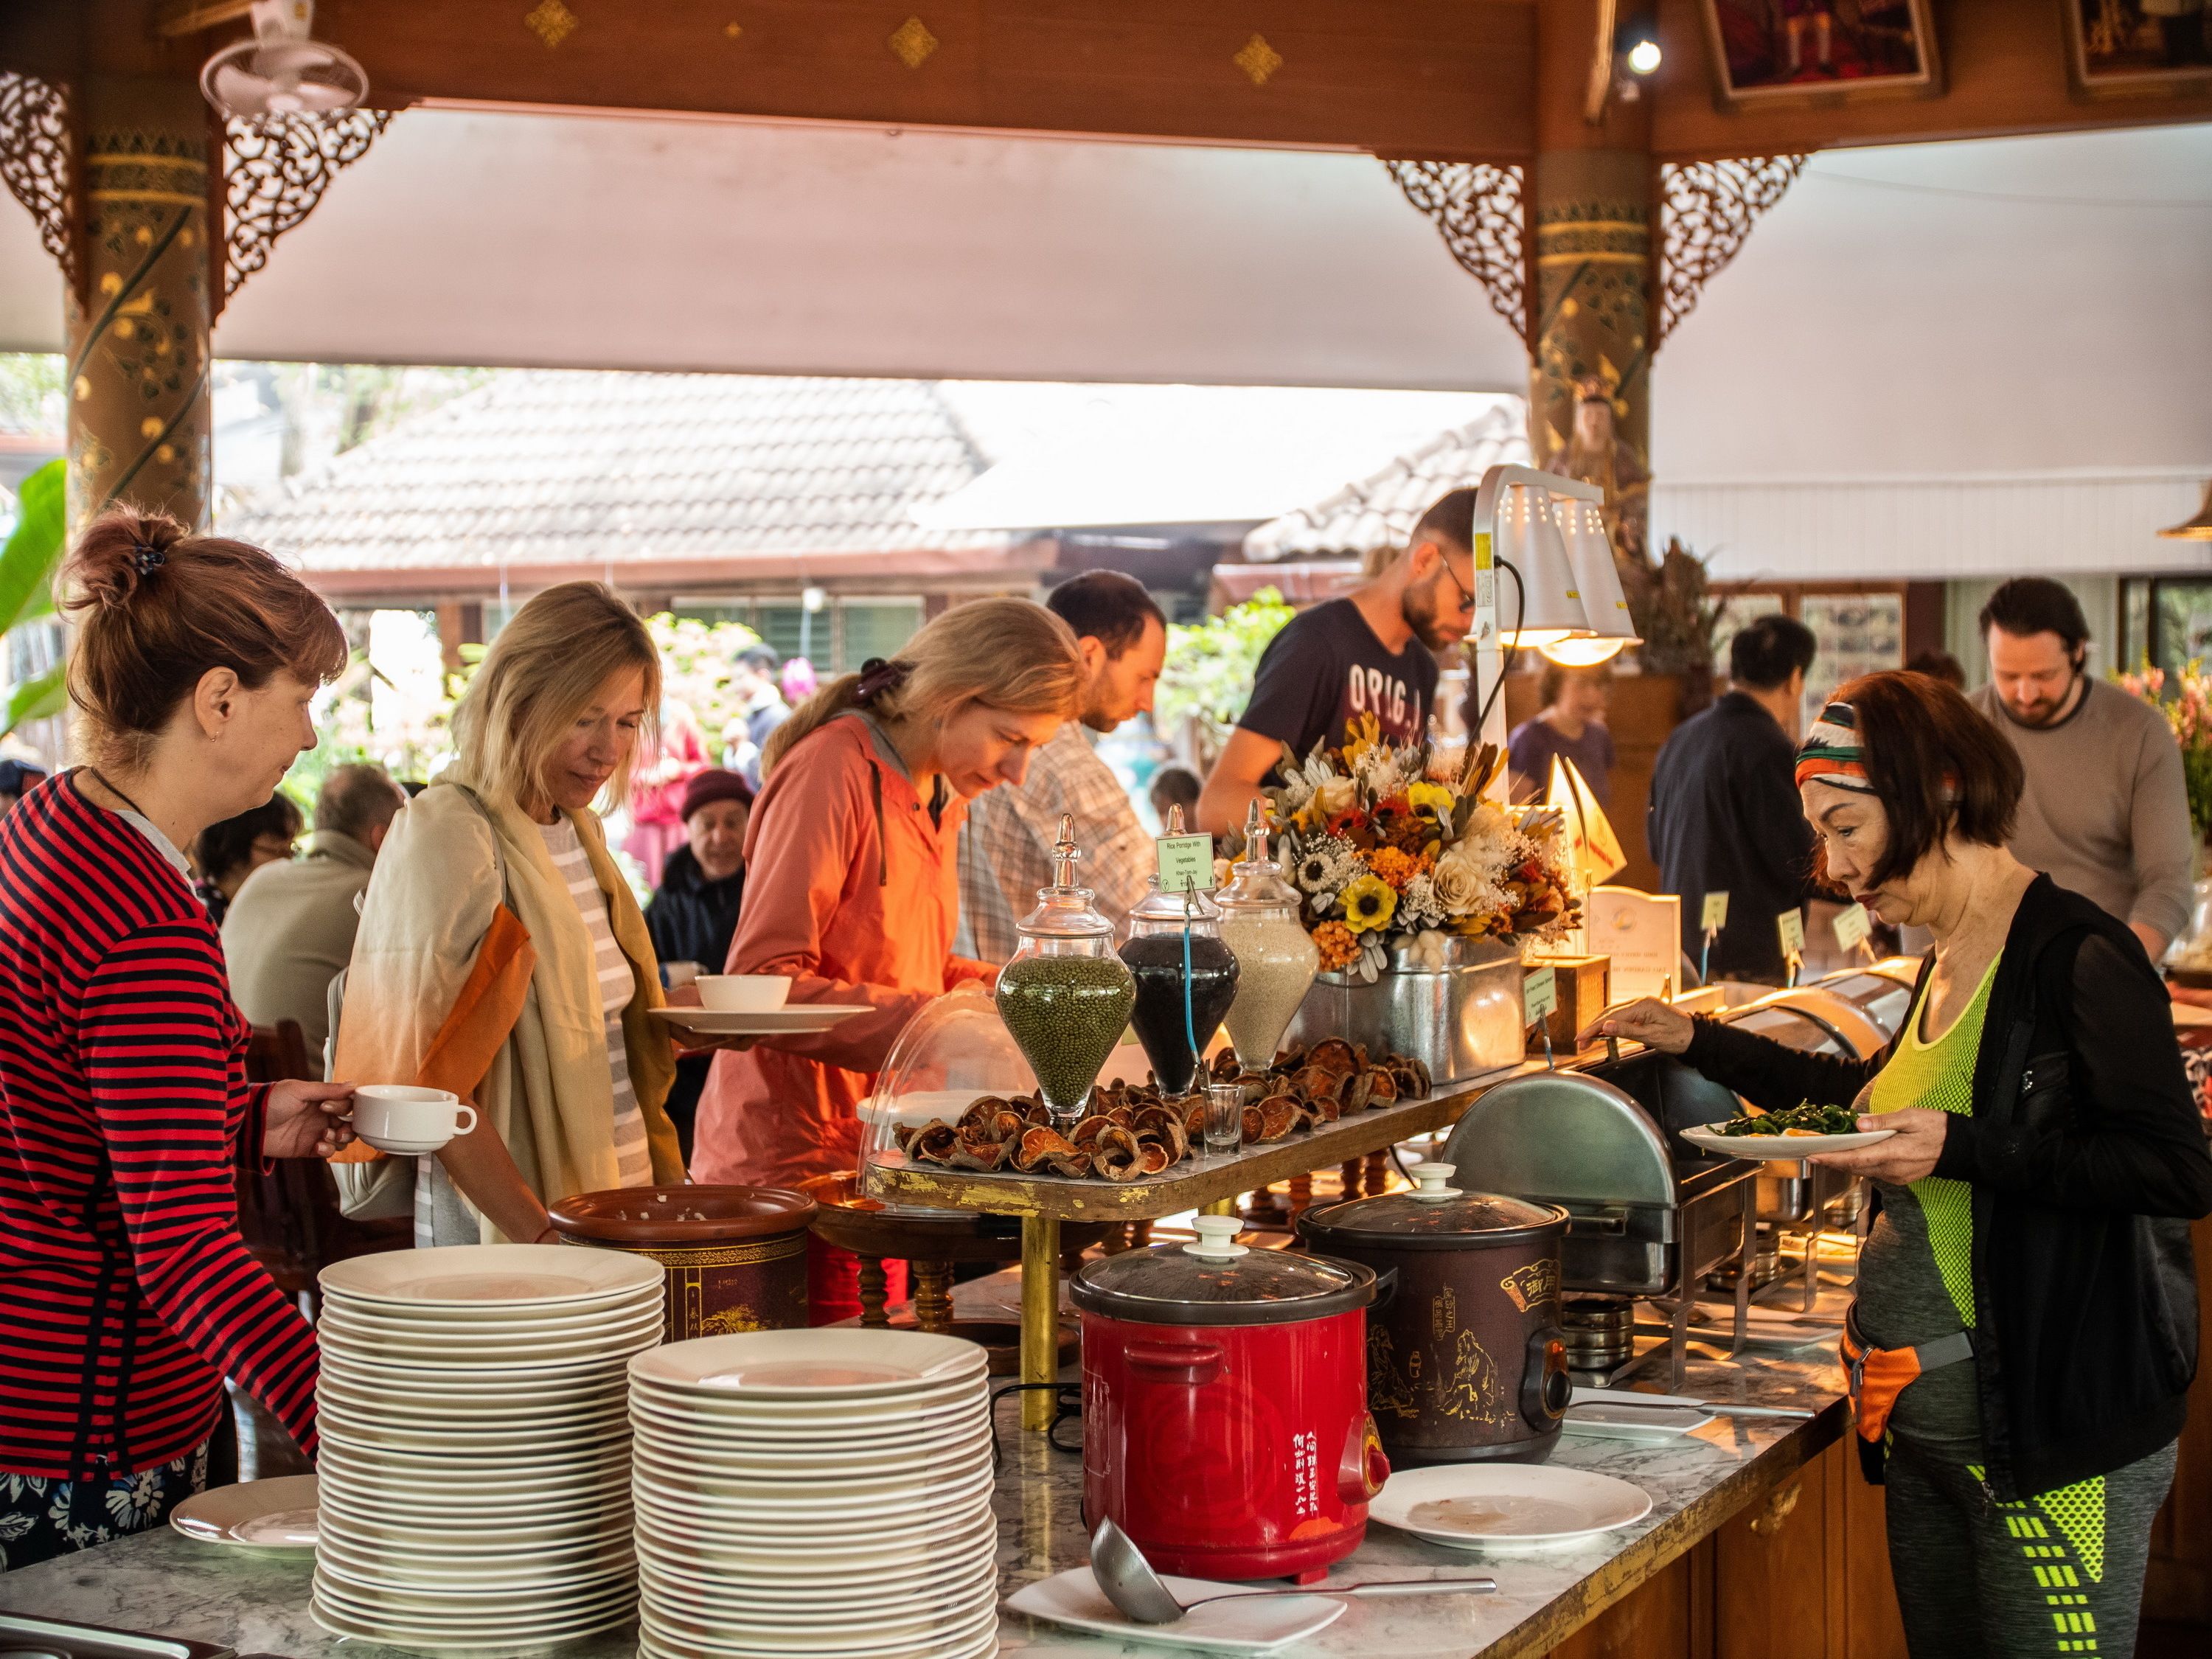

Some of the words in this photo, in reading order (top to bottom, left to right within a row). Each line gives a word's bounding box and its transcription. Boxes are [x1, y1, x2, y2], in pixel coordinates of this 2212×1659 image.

[1176, 841, 1192, 849] Porridge
[1175, 856, 1197, 864] Vegetables
[1526, 1275, 1556, 1297] 御用
